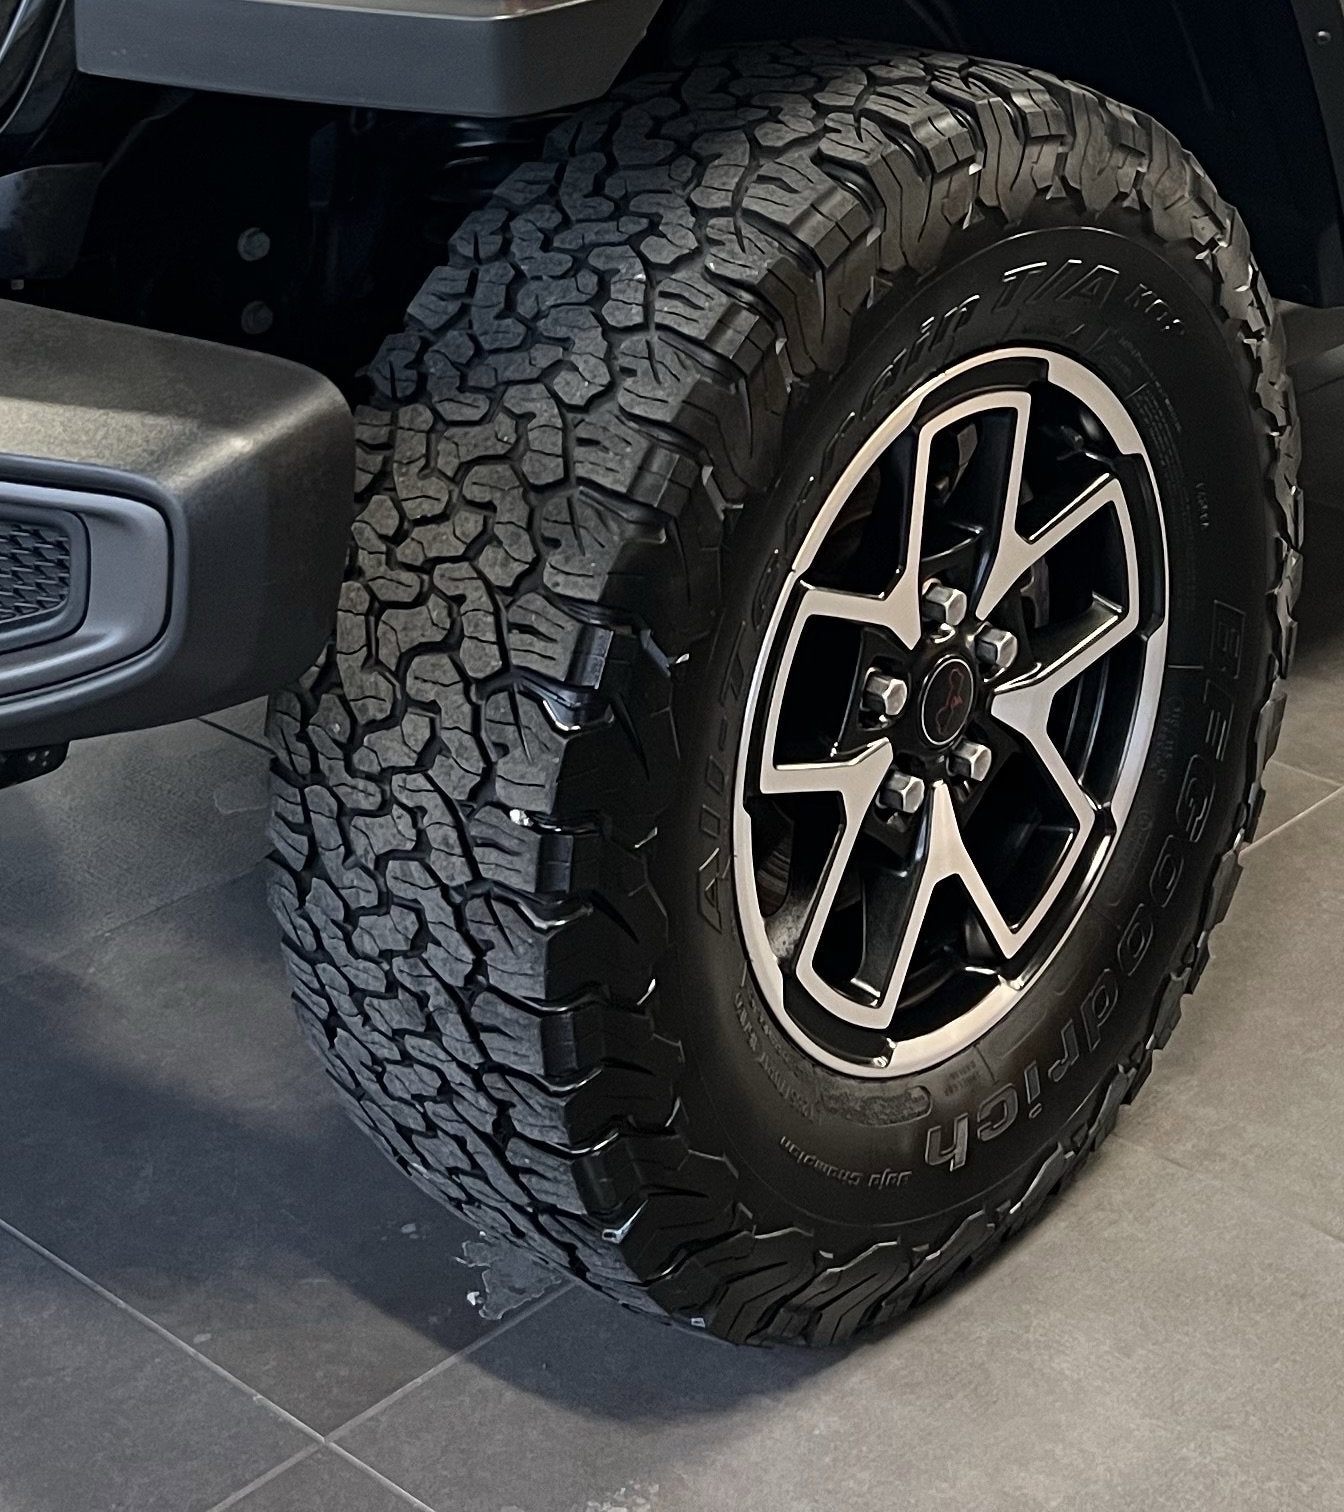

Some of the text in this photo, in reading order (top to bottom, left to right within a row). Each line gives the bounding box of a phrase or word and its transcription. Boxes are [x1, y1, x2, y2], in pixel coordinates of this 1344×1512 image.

[992, 259, 1120, 313] T/A
[924, 599, 1246, 1173] BFGoodrich
[779, 1134, 862, 1188] Champion
